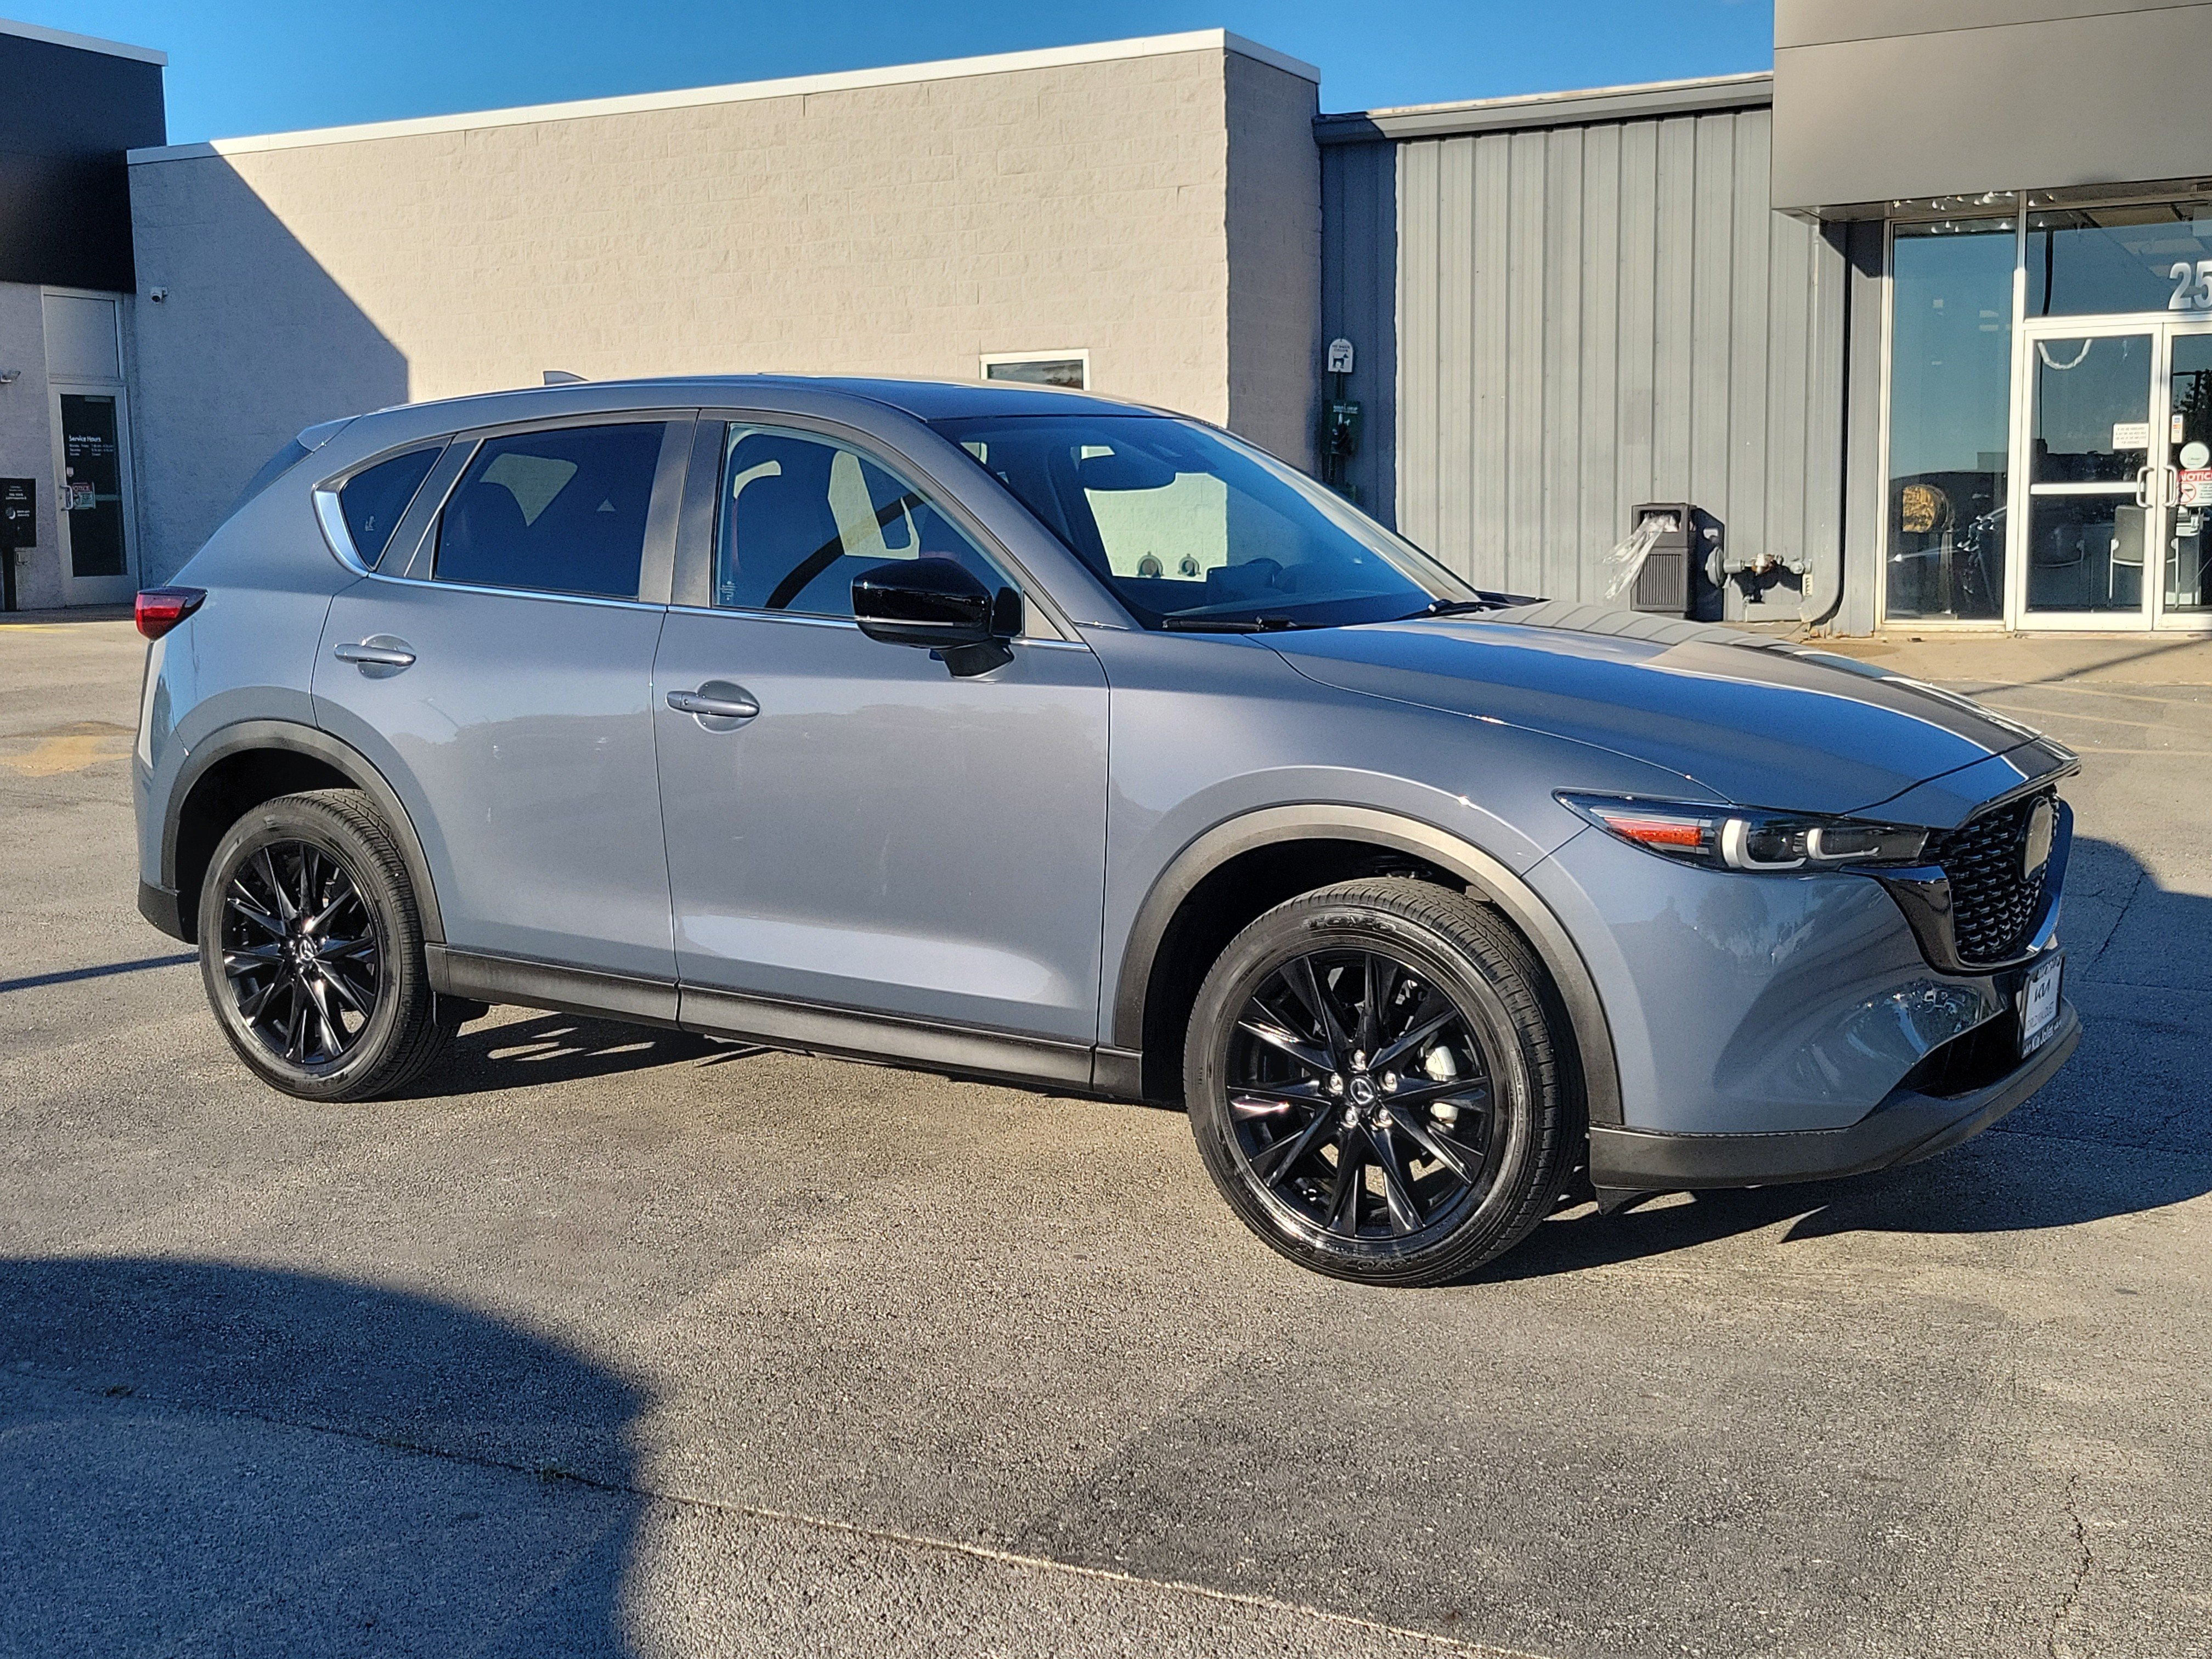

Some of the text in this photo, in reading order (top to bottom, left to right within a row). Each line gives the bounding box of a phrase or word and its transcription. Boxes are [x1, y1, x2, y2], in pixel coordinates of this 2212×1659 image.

[2168, 261, 2212, 310] 25
[2181, 471, 2212, 481] NOTIC
[2034, 978, 2051, 1003] KIA
